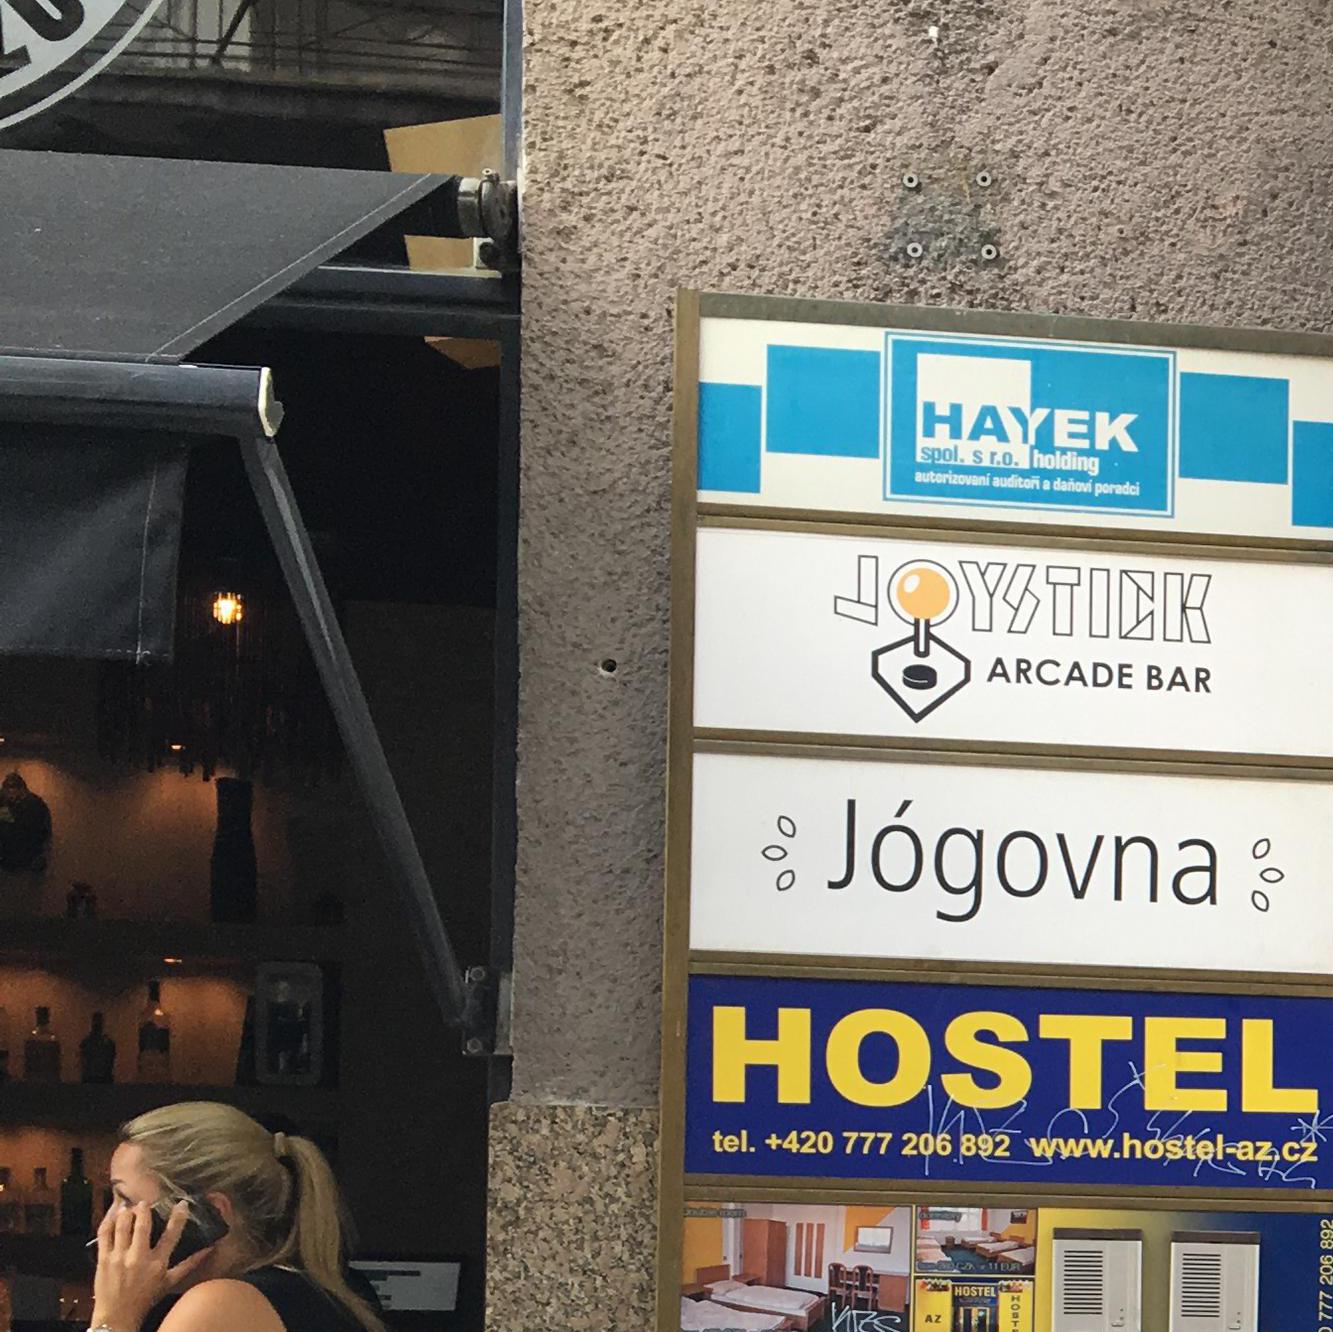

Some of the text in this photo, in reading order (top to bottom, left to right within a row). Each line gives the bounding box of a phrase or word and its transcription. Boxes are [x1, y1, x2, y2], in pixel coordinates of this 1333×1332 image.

[922, 401, 1139, 452] HAYEK
[921, 445, 1099, 476] spol. s r.o. holding
[915, 469, 1140, 497] autorizovaní auditoři a daňoví poradci
[987, 657, 1212, 694] ARCADE BAR
[827, 798, 1219, 923] Jógovna
[712, 1005, 1318, 1114] HOSTEL
[712, 1129, 1318, 1162] tel. +420 777 206 892 www.hostel-az.cz
[954, 1286, 997, 1297] HOSTEL
[1319, 1291, 1333, 1322] 777
